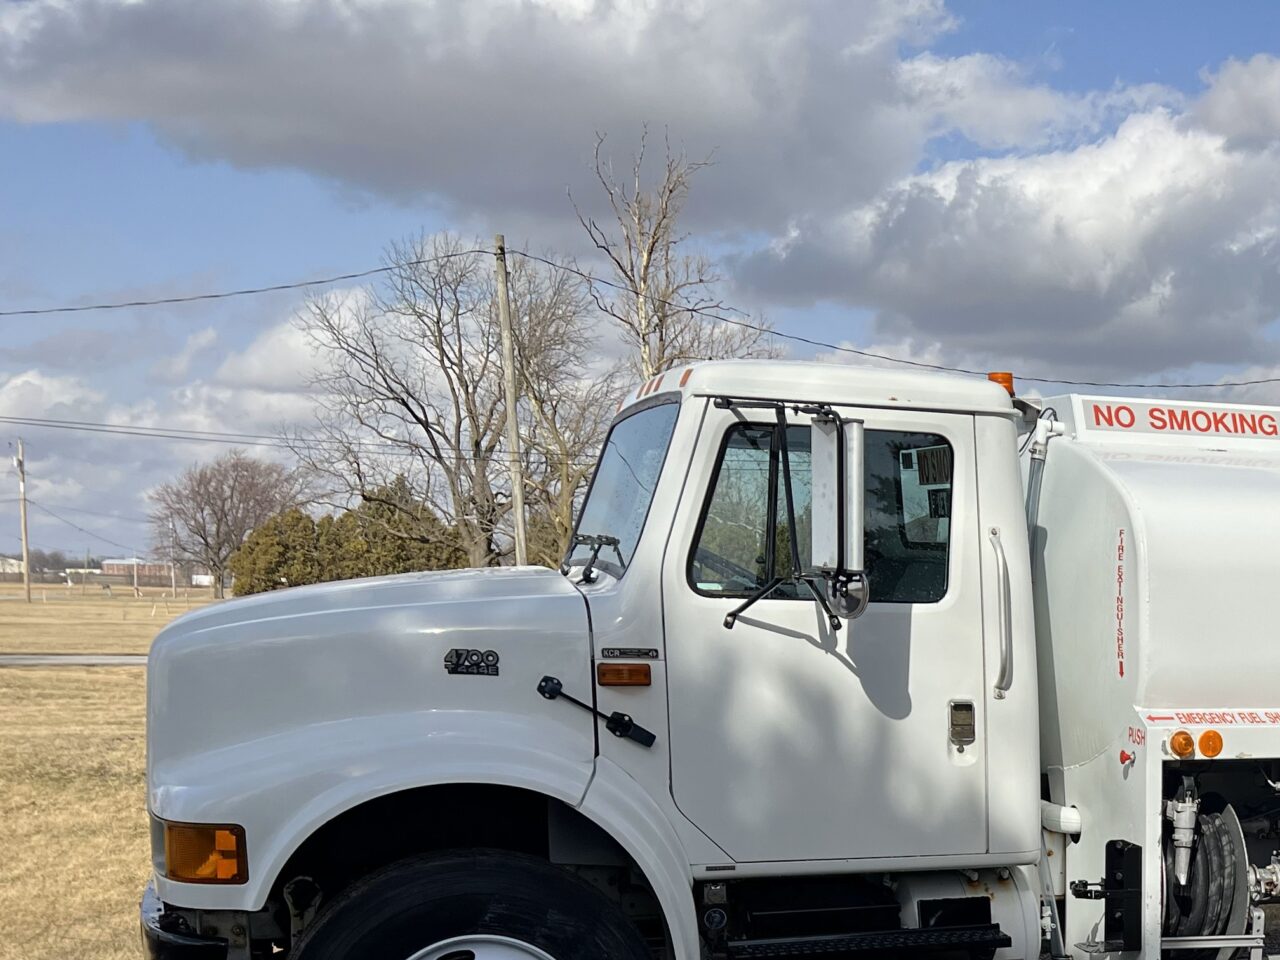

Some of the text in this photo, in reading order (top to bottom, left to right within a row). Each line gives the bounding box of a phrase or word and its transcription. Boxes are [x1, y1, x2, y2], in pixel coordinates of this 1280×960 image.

[1093, 404, 1279, 436] NO SMOKING
[1116, 529, 1125, 659] FIRE EXTINGUISHER
[444, 649, 499, 666] 4700
[1175, 712, 1238, 725] EMERGENCY
[1239, 712, 1265, 725] FUEL
[1128, 726, 1146, 746] PUSH
